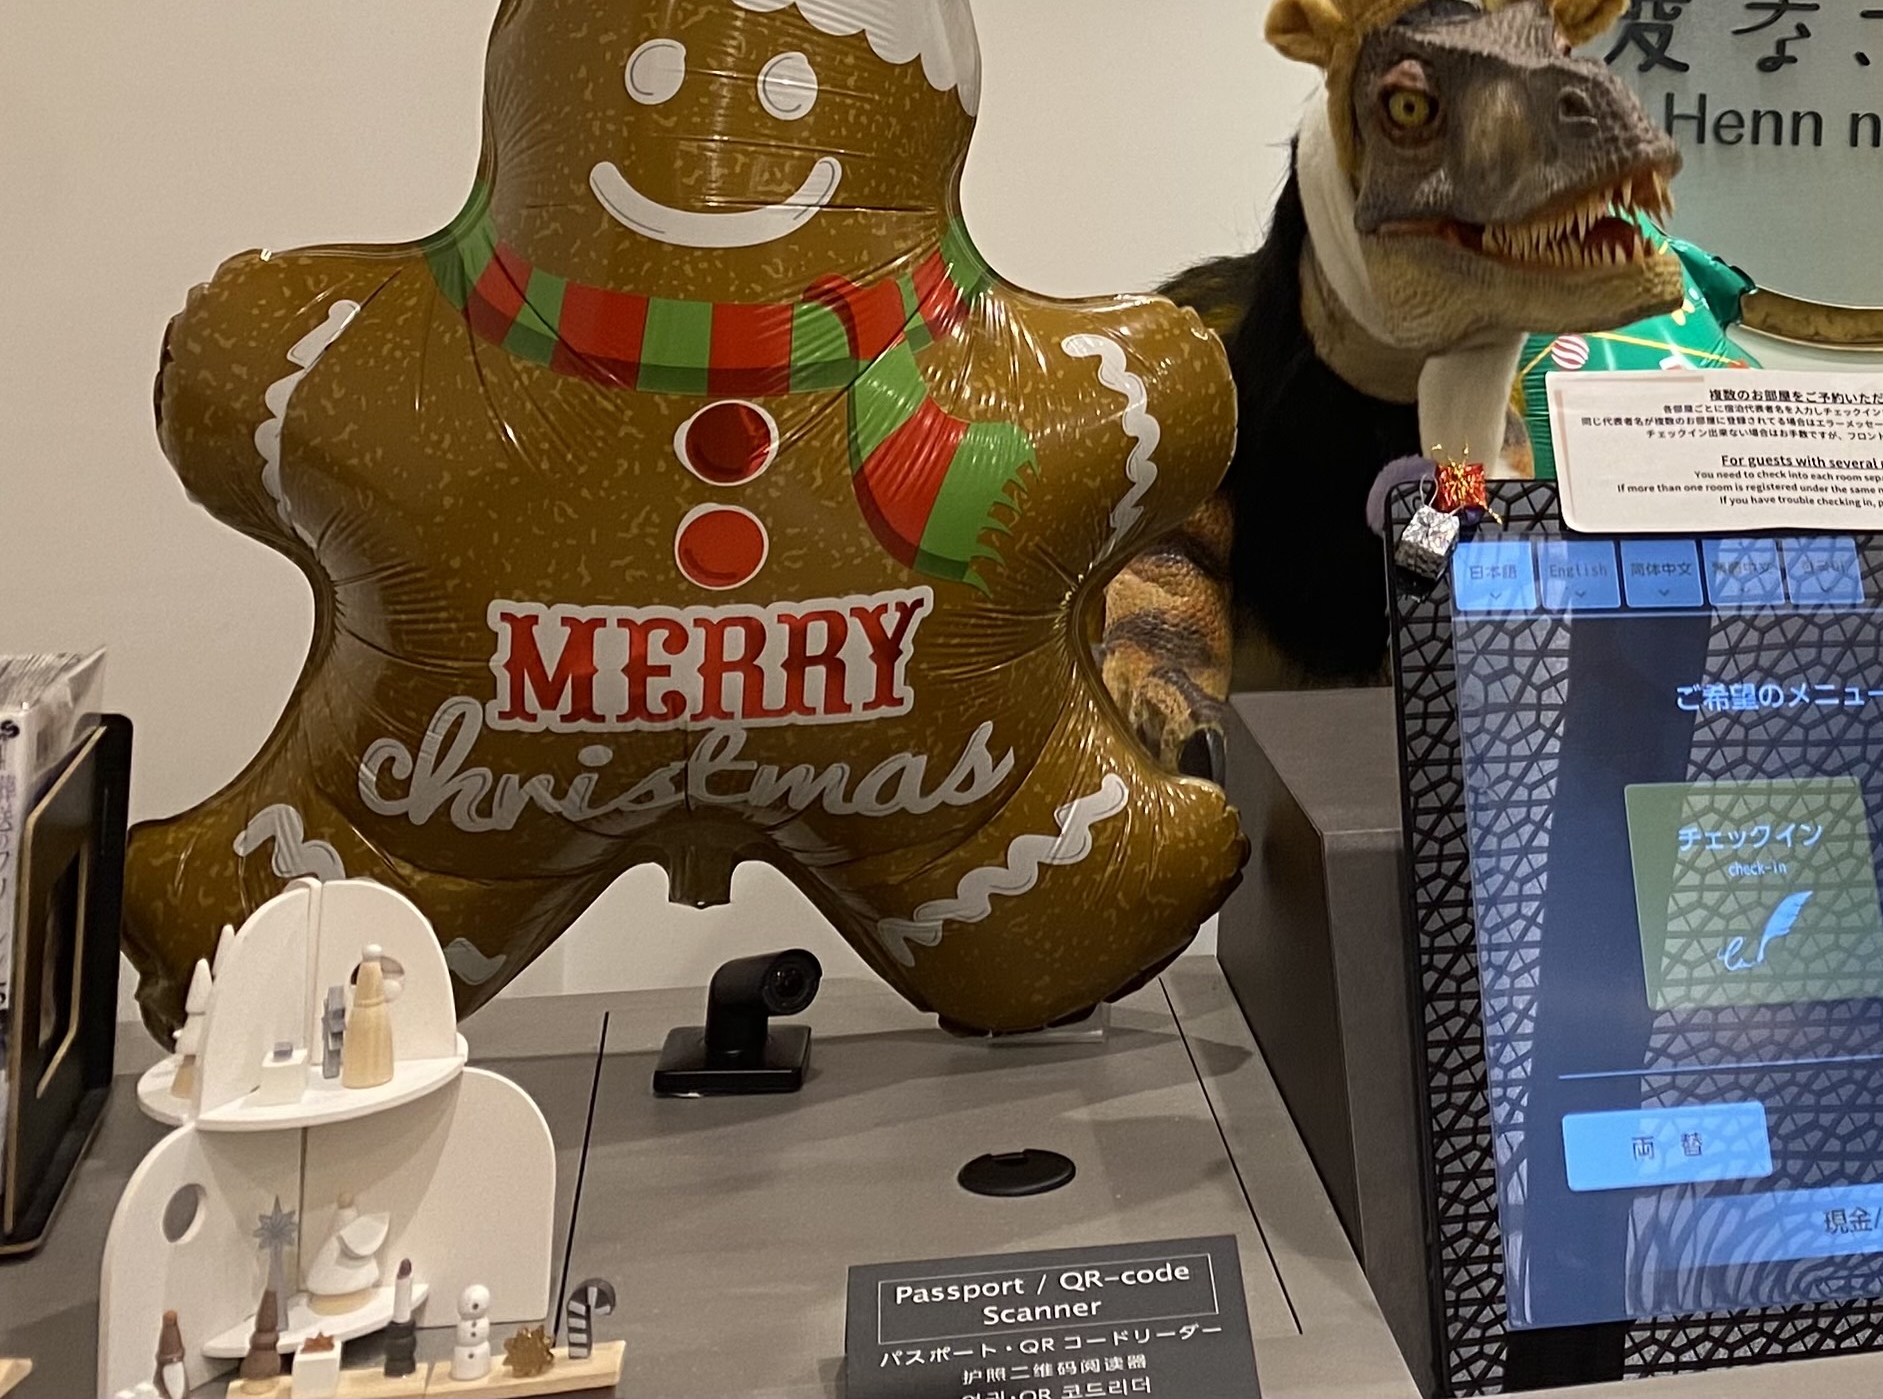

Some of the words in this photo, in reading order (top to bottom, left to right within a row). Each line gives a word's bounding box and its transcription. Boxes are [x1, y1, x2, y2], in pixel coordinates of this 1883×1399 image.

[1664, 92, 1823, 148] Henn
[1721, 455, 1745, 467] For
[1748, 456, 1793, 469] guests
[1795, 455, 1826, 468] with
[1829, 457, 1878, 469] several
[1694, 471, 1715, 479] You
[1716, 470, 1741, 479] need
[1744, 471, 1755, 479] to
[1757, 470, 1786, 479] check
[1788, 470, 1809, 480] into
[1811, 471, 1834, 481] each
[1836, 473, 1862, 481] room
[1657, 484, 1682, 492] than
[1706, 484, 1733, 492] room
[1746, 483, 1798, 494] registered
[1800, 484, 1829, 493] under
[1831, 485, 1848, 494] the
[1850, 487, 1876, 495] same
[1729, 497, 1749, 507] you
[1750, 496, 1776, 505] have
[1778, 496, 1815, 505] trouble
[1817, 497, 1862, 508] checking
[1469, 563, 1517, 580] 日本語
[1548, 563, 1608, 579] English
[1631, 562, 1693, 577] 简体中文
[497, 596, 926, 725] MERRY
[1679, 822, 1822, 853] チェックイン
[1728, 861, 1787, 876] check-in
[896, 1276, 1025, 1305] Passport
[1059, 1263, 1191, 1292] QR-code
[982, 1299, 1102, 1327] Scanner
[961, 1354, 1147, 1386] 护照二维码阅读器
